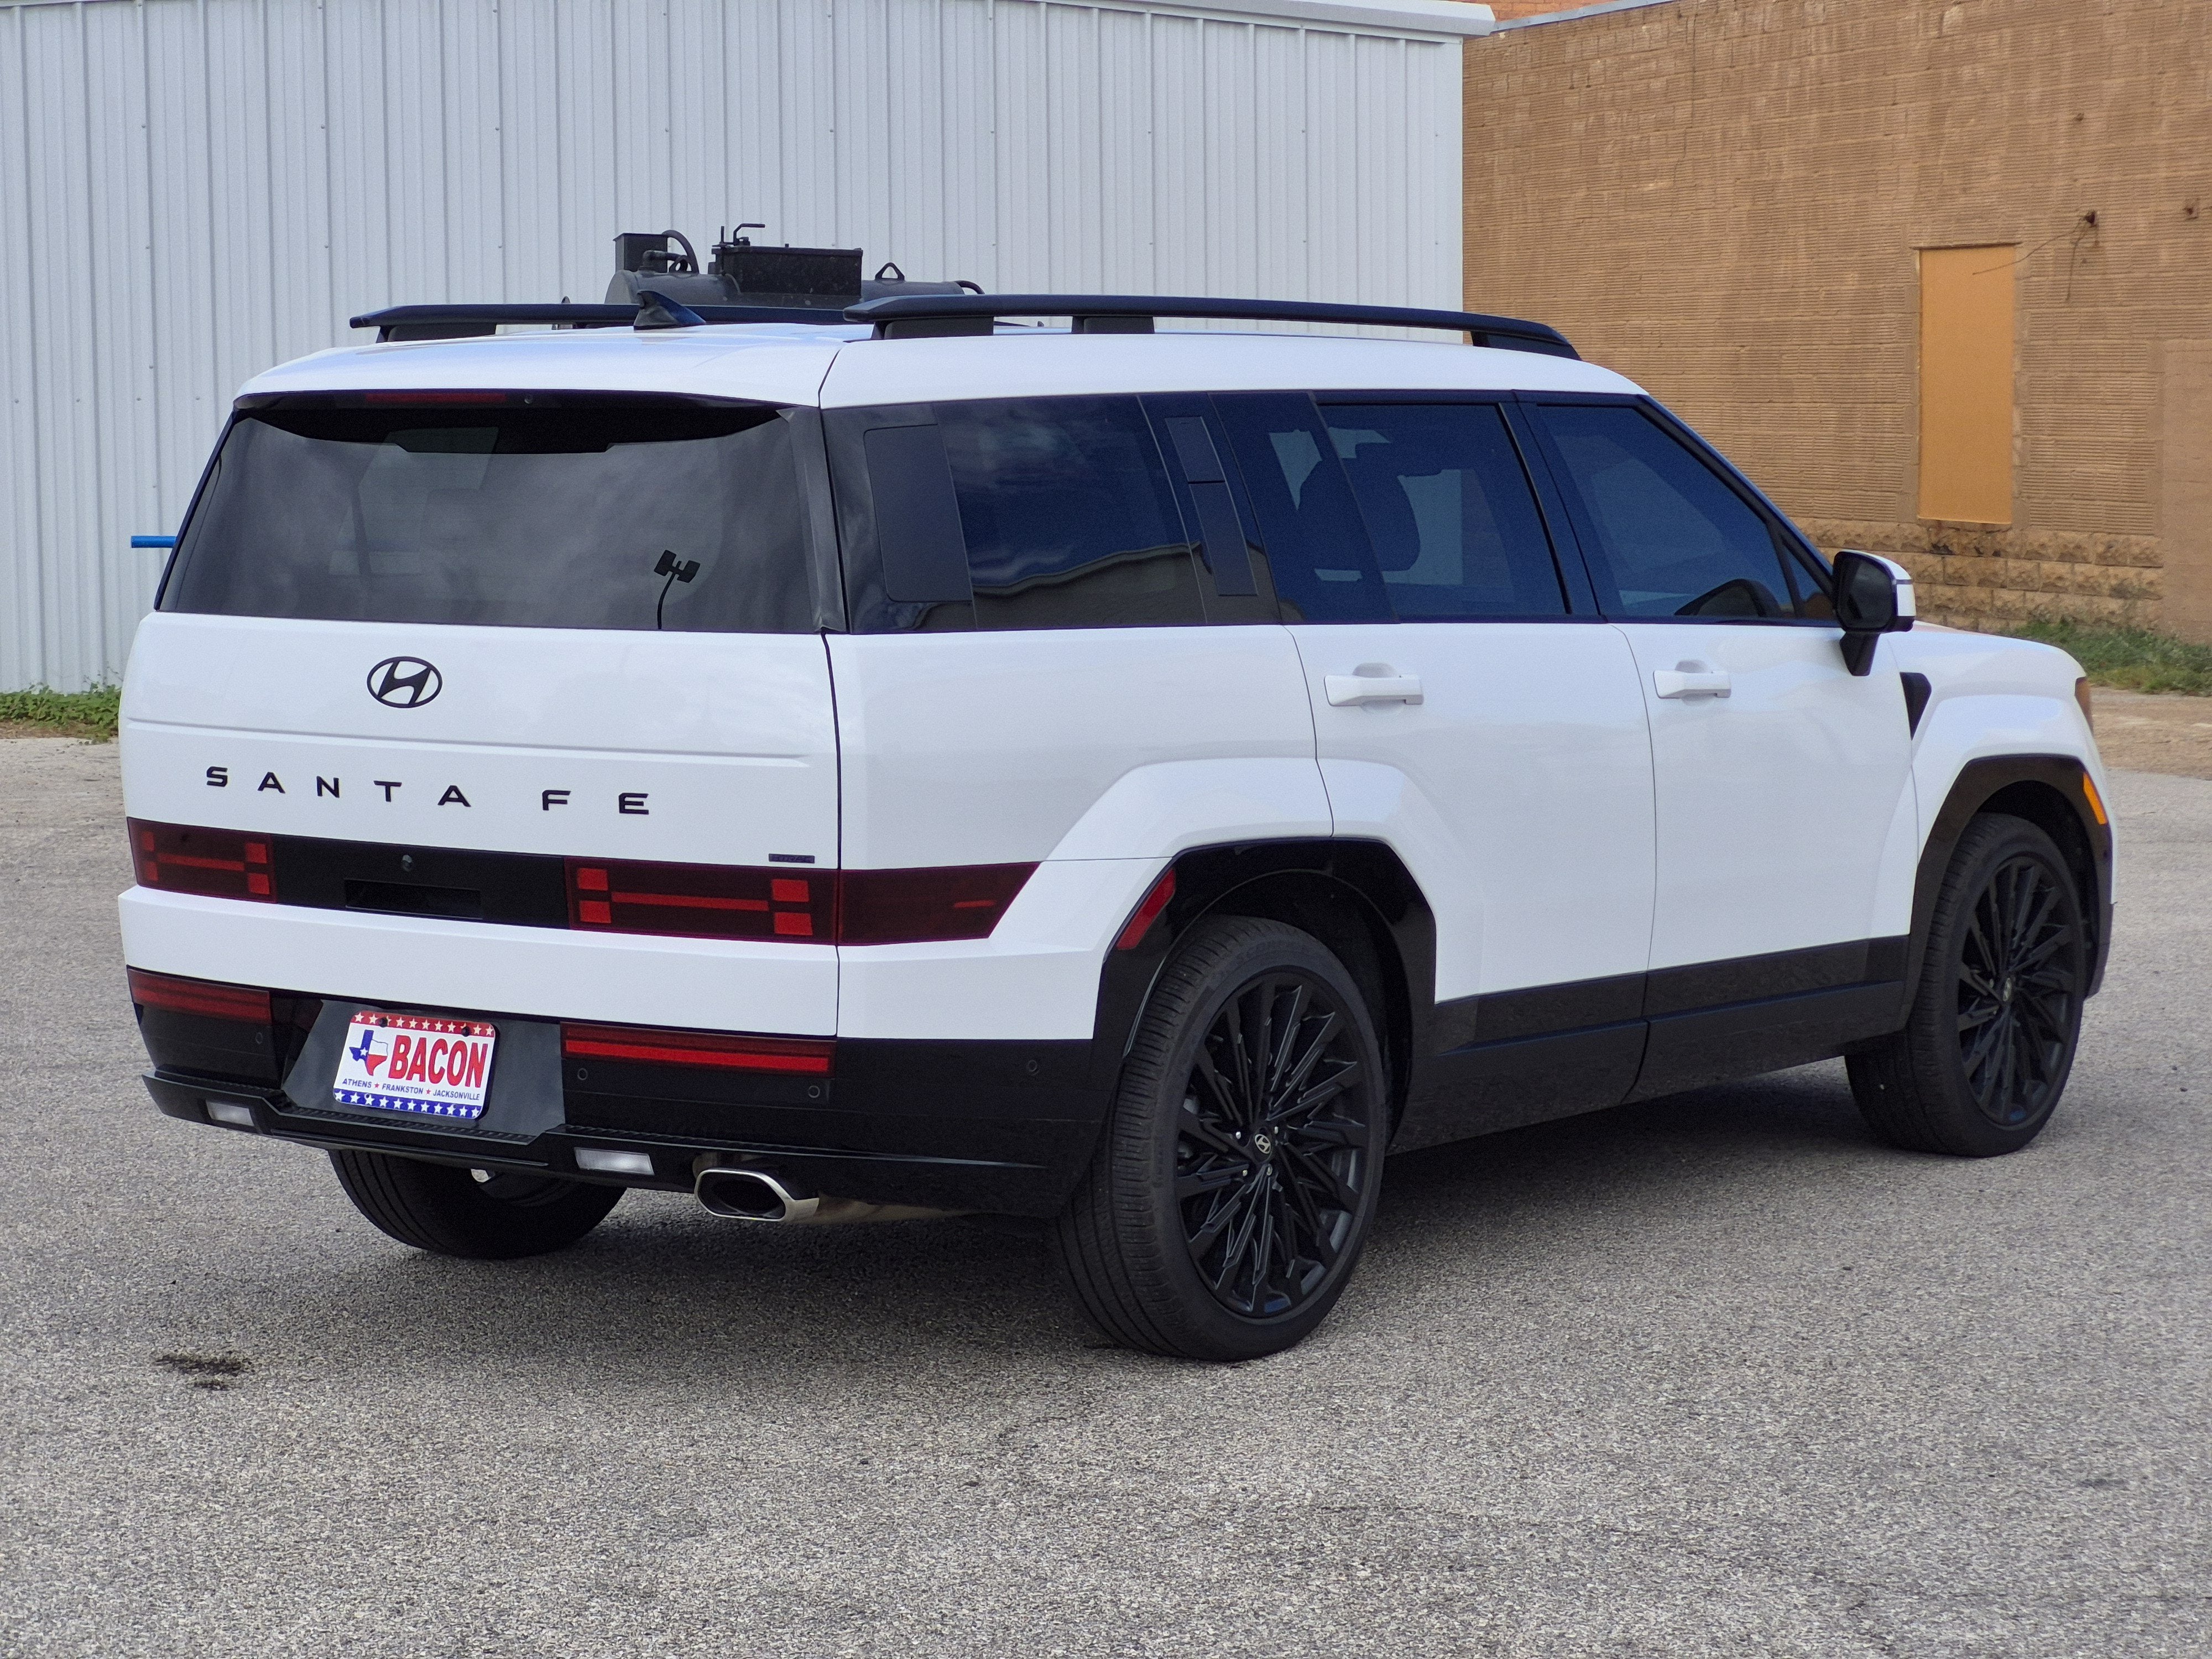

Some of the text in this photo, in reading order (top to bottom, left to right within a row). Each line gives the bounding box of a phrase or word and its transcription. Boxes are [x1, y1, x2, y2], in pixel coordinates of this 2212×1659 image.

[206, 766, 649, 815] SANTA FE
[388, 1035, 488, 1088] BACON
[342, 1078, 480, 1100] ATHENS FRANKSTON JACKSONVILLE
